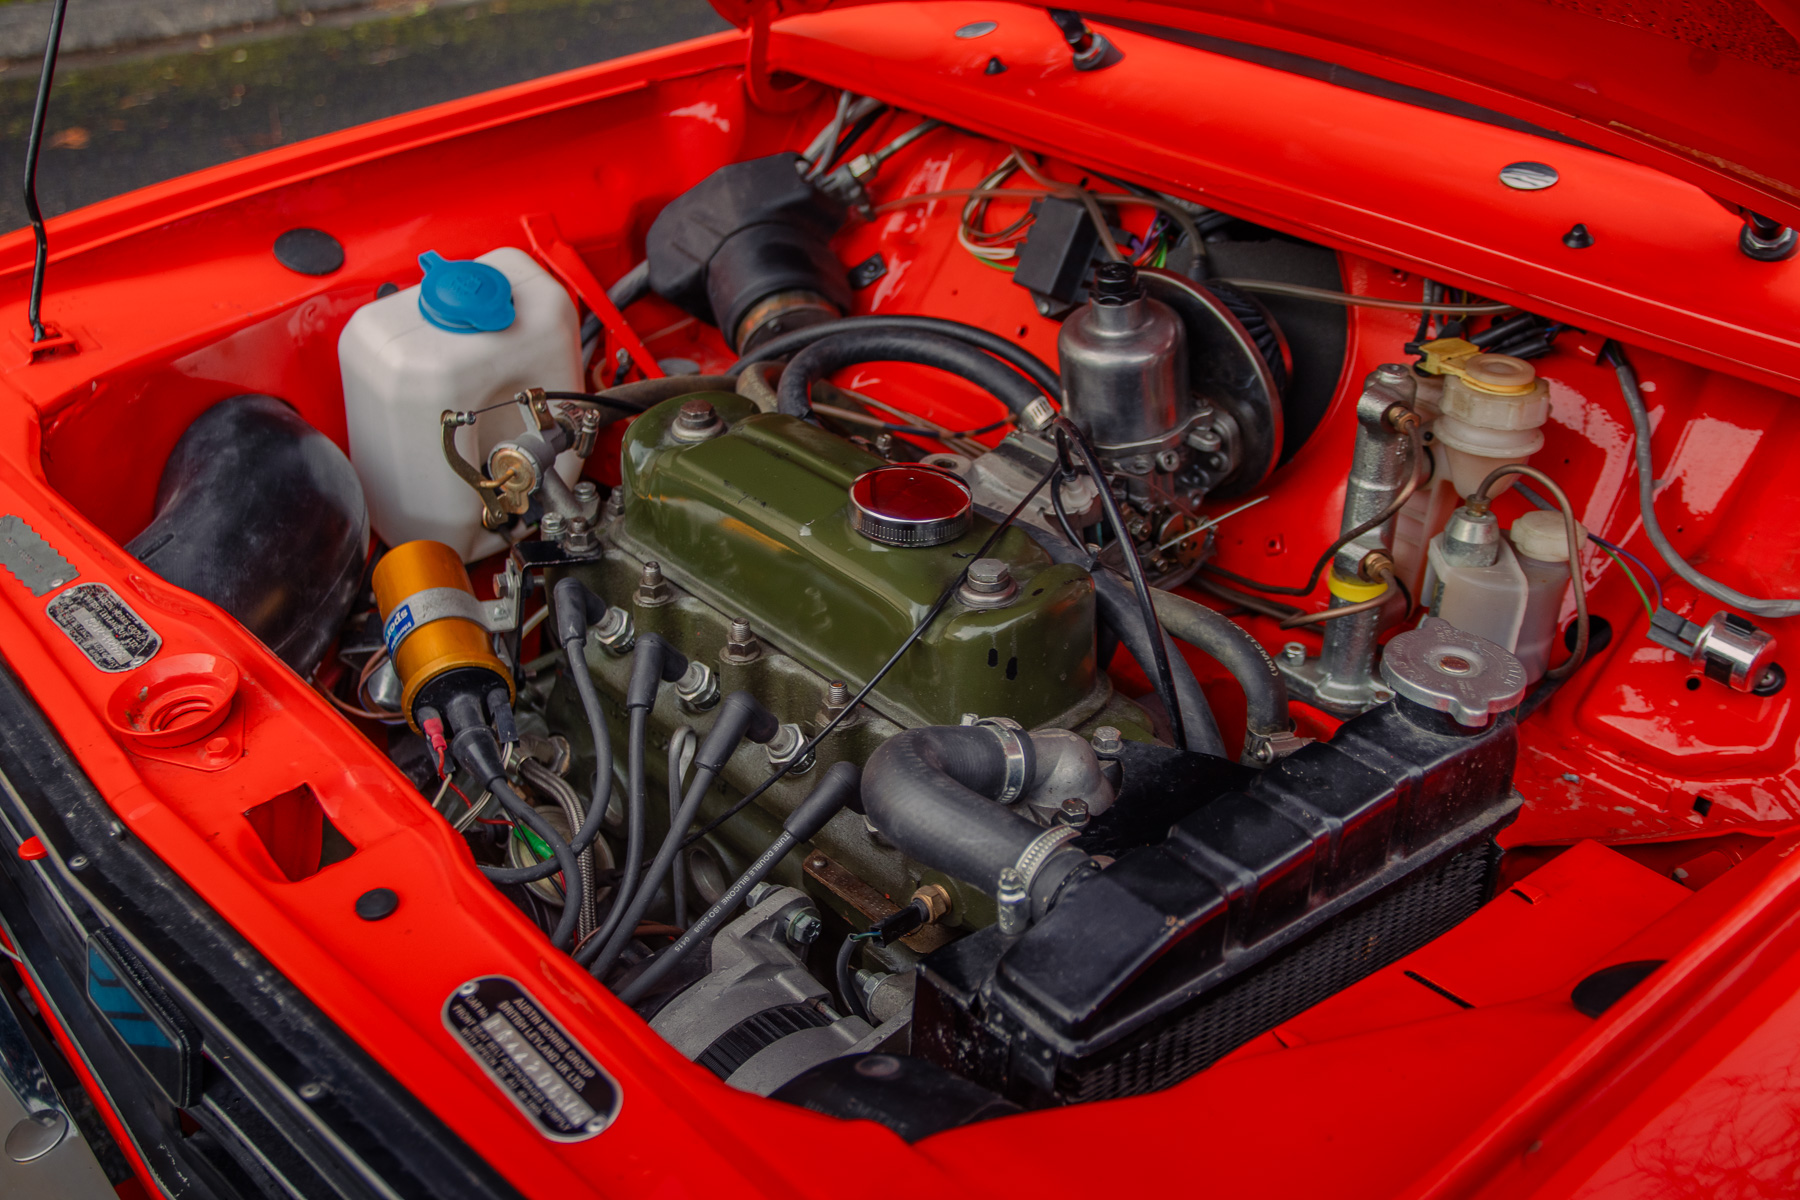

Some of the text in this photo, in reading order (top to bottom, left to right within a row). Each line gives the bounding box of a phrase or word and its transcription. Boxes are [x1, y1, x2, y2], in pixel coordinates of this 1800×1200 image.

[773, 832, 791, 852] TURE
[749, 851, 775, 877] DOUBLE
[721, 875, 751, 906] SILICONE
[709, 905, 722, 918] ISO
[674, 936, 691, 952] 0415
[464, 994, 481, 1010] CAR
[497, 1000, 529, 1031] BRITISH
[523, 1027, 561, 1064] LEYLAND
[555, 1059, 571, 1074] UK
[512, 997, 595, 1078] AUSTIN MORRIS GROUP
[452, 1004, 476, 1027] FRONT
[541, 1101, 572, 1130] COMPLY
